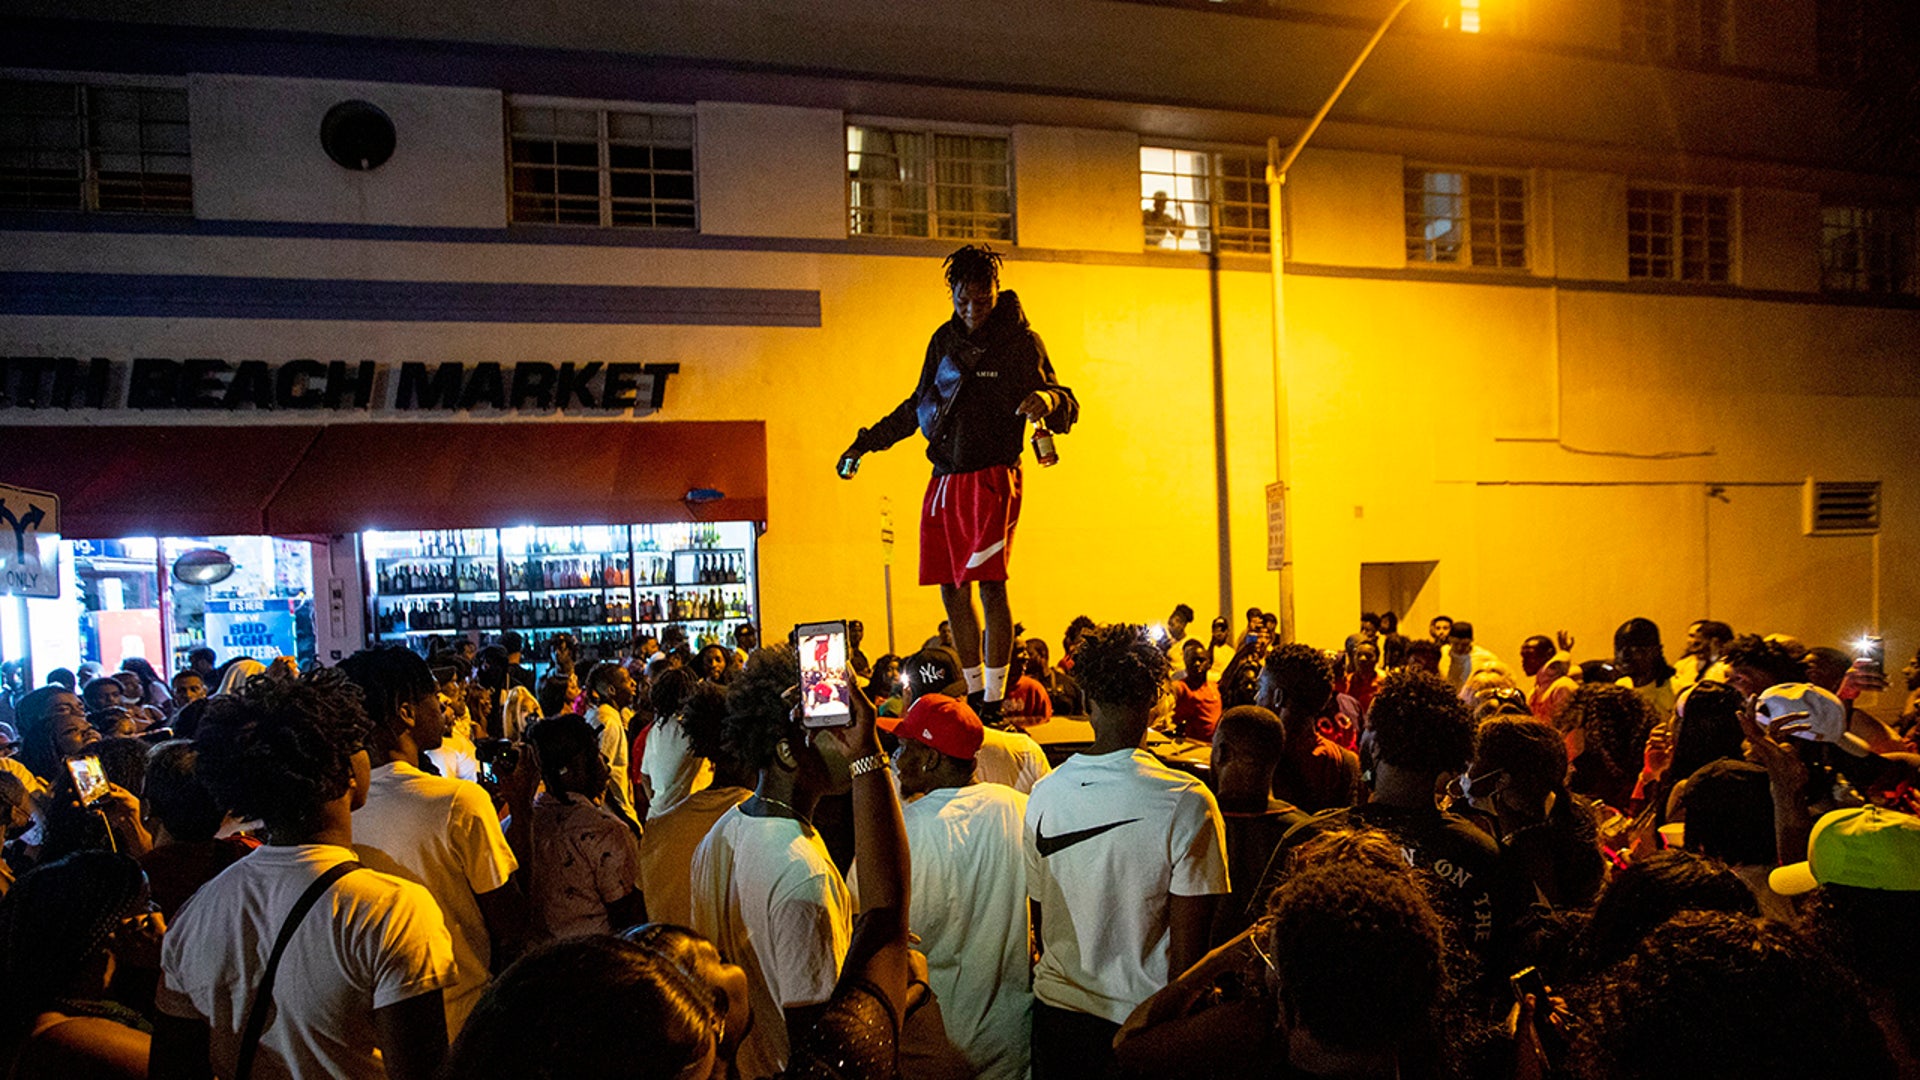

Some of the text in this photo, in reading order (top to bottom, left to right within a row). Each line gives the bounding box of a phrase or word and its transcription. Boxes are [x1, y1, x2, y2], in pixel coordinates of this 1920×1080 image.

[0, 358, 680, 412] TH BEACH MARKET
[5, 570, 39, 589] ONLY
[229, 623, 268, 635] BUD
[223, 633, 274, 647] LIGHT
